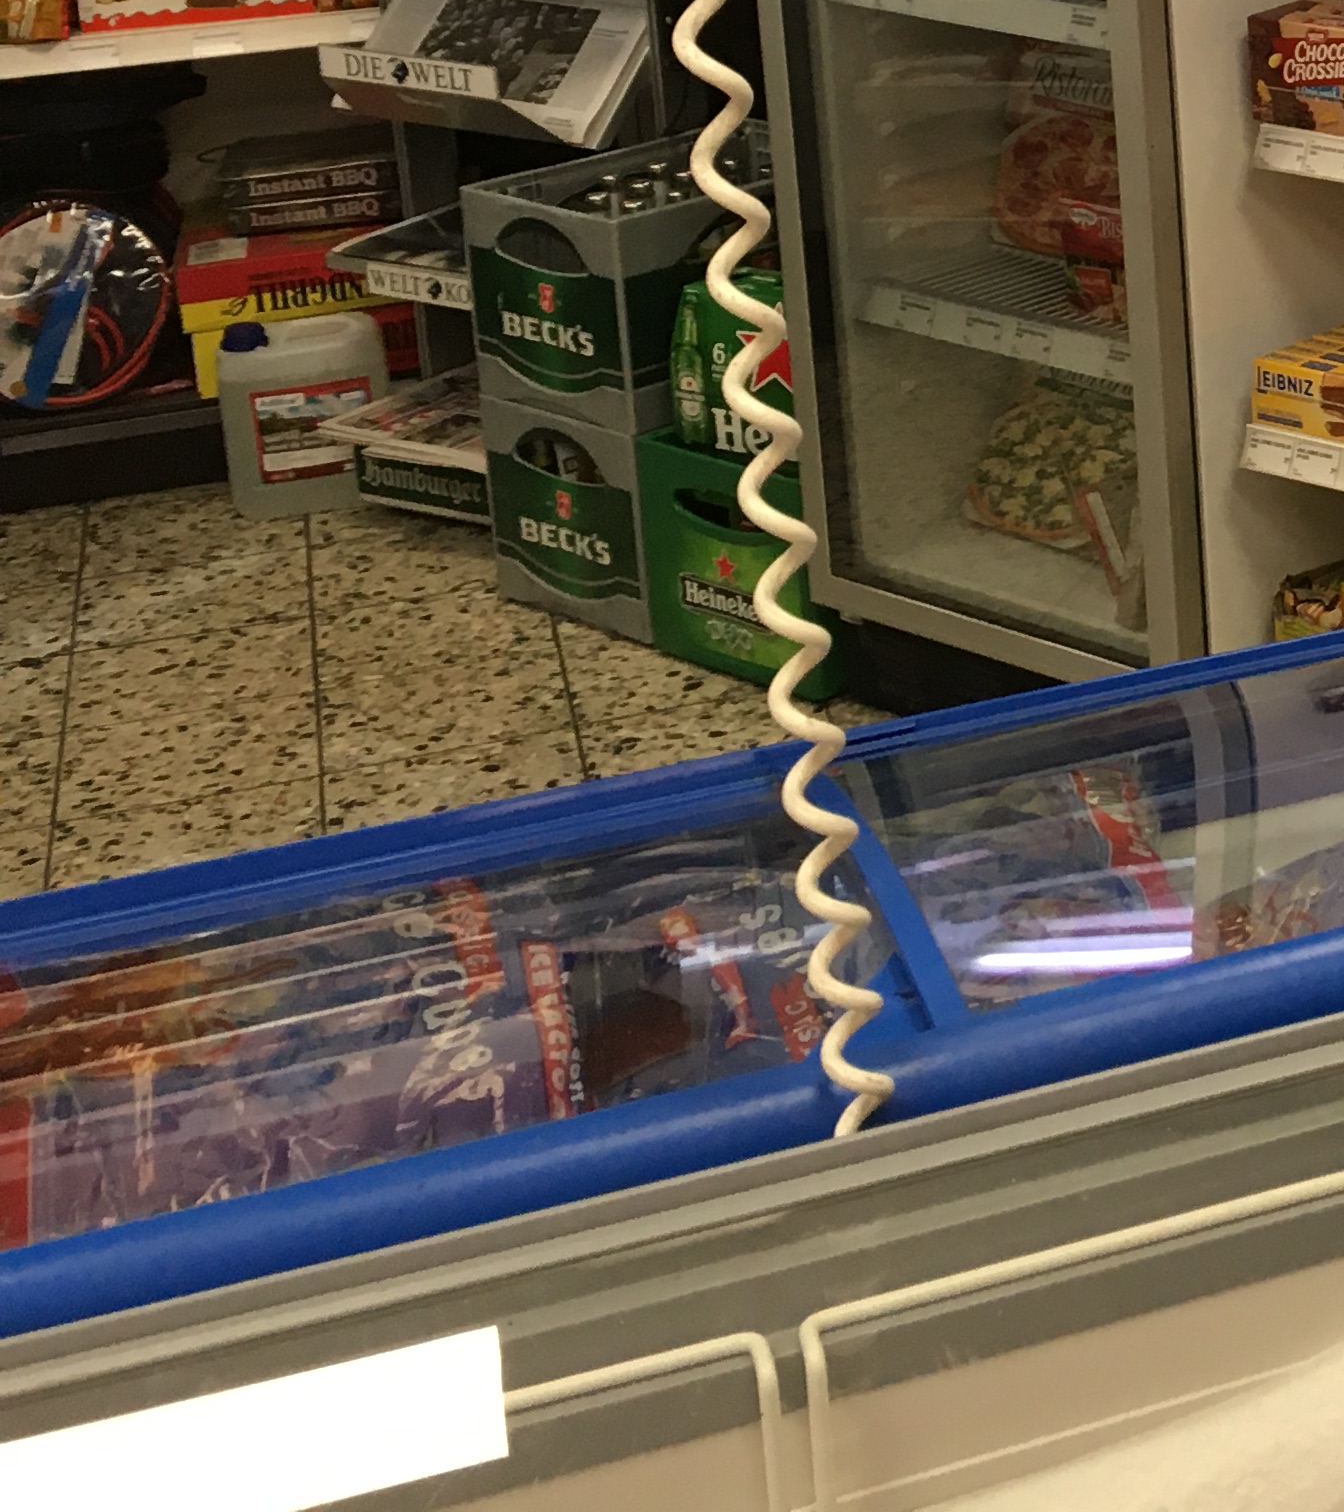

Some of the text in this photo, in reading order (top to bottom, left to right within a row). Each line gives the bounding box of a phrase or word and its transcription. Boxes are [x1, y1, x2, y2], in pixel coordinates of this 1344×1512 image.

[344, 53, 473, 92] DIE WELT
[249, 168, 377, 196] Instant BBQ
[250, 198, 380, 227] Instant BBQ
[369, 269, 420, 295] WELT
[501, 309, 595, 358] BECK'S
[1255, 364, 1315, 398] LEIBNIZ
[519, 516, 611, 566] BECK'S
